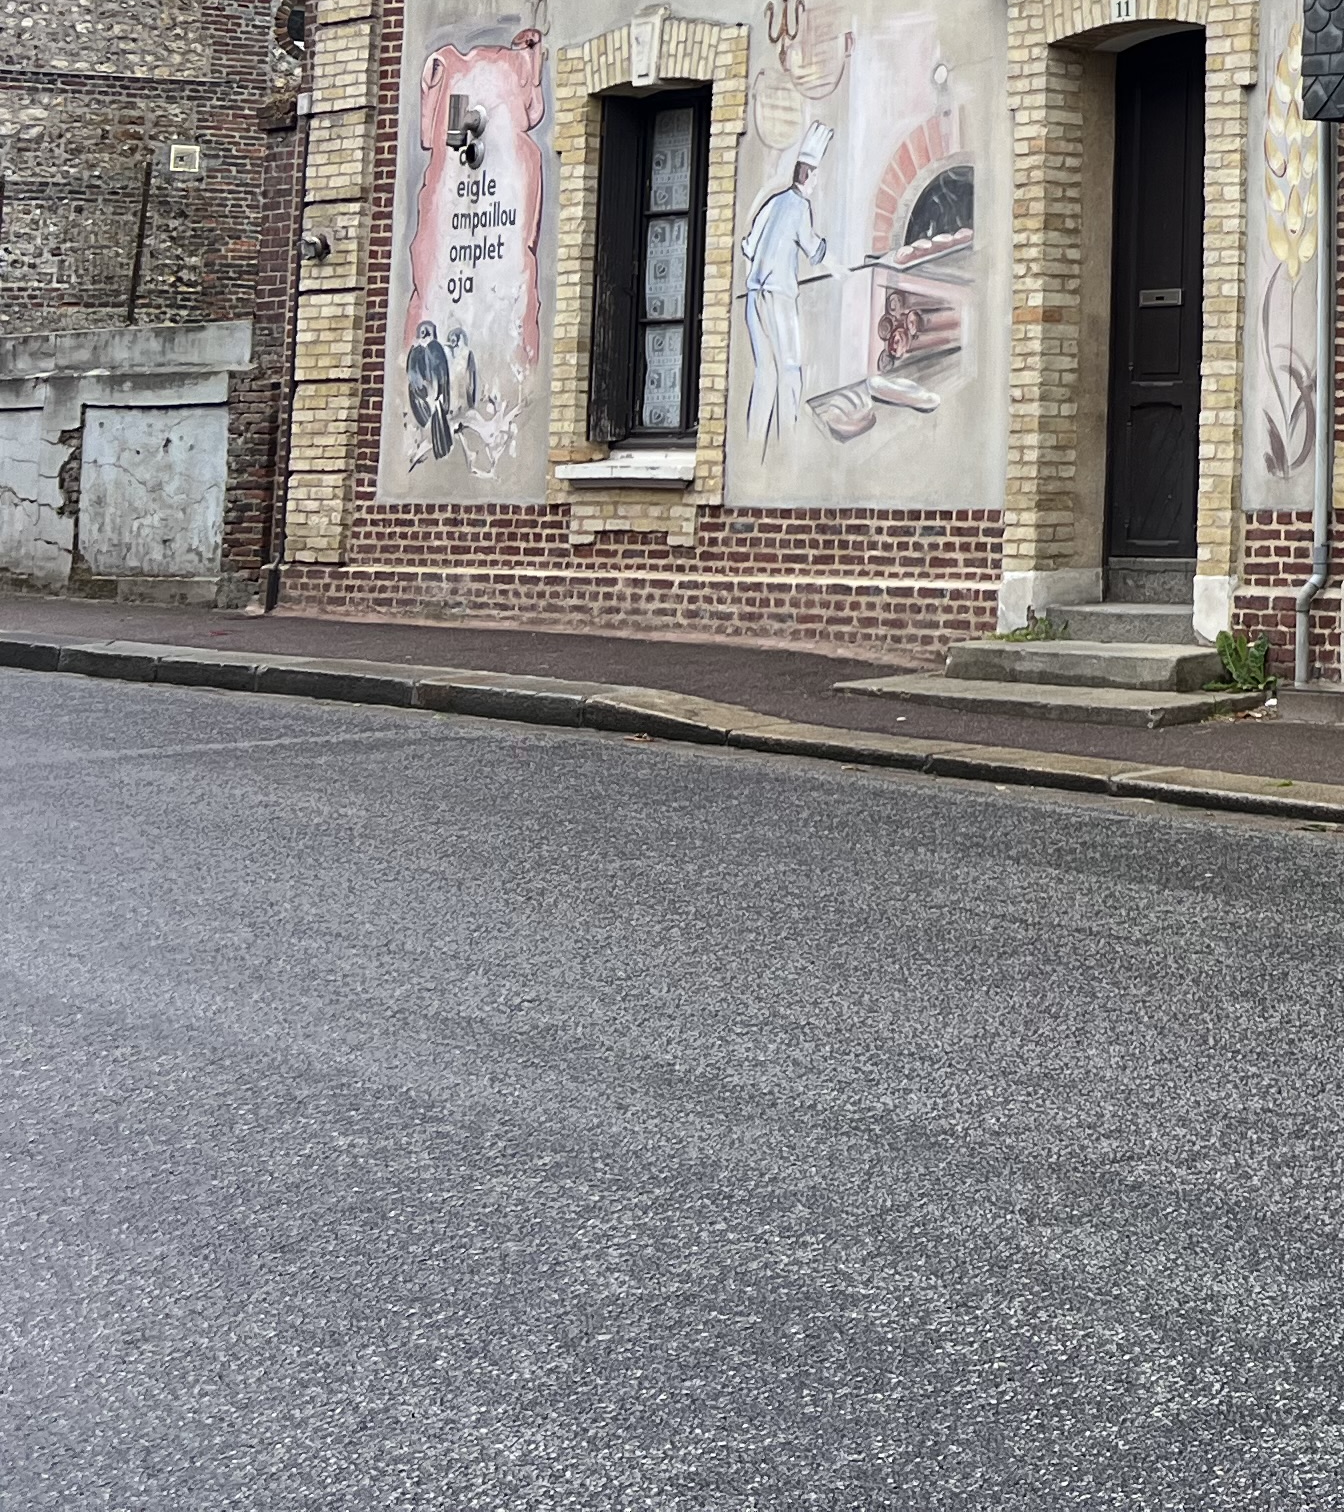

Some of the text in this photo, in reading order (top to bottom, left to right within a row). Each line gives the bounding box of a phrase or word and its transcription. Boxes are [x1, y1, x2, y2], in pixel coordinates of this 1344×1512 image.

[1115, 0, 1131, 19] 11
[456, 169, 497, 205] eigle
[451, 201, 517, 236] ampaillou
[449, 234, 505, 269] omplet
[447, 270, 474, 304] oja
